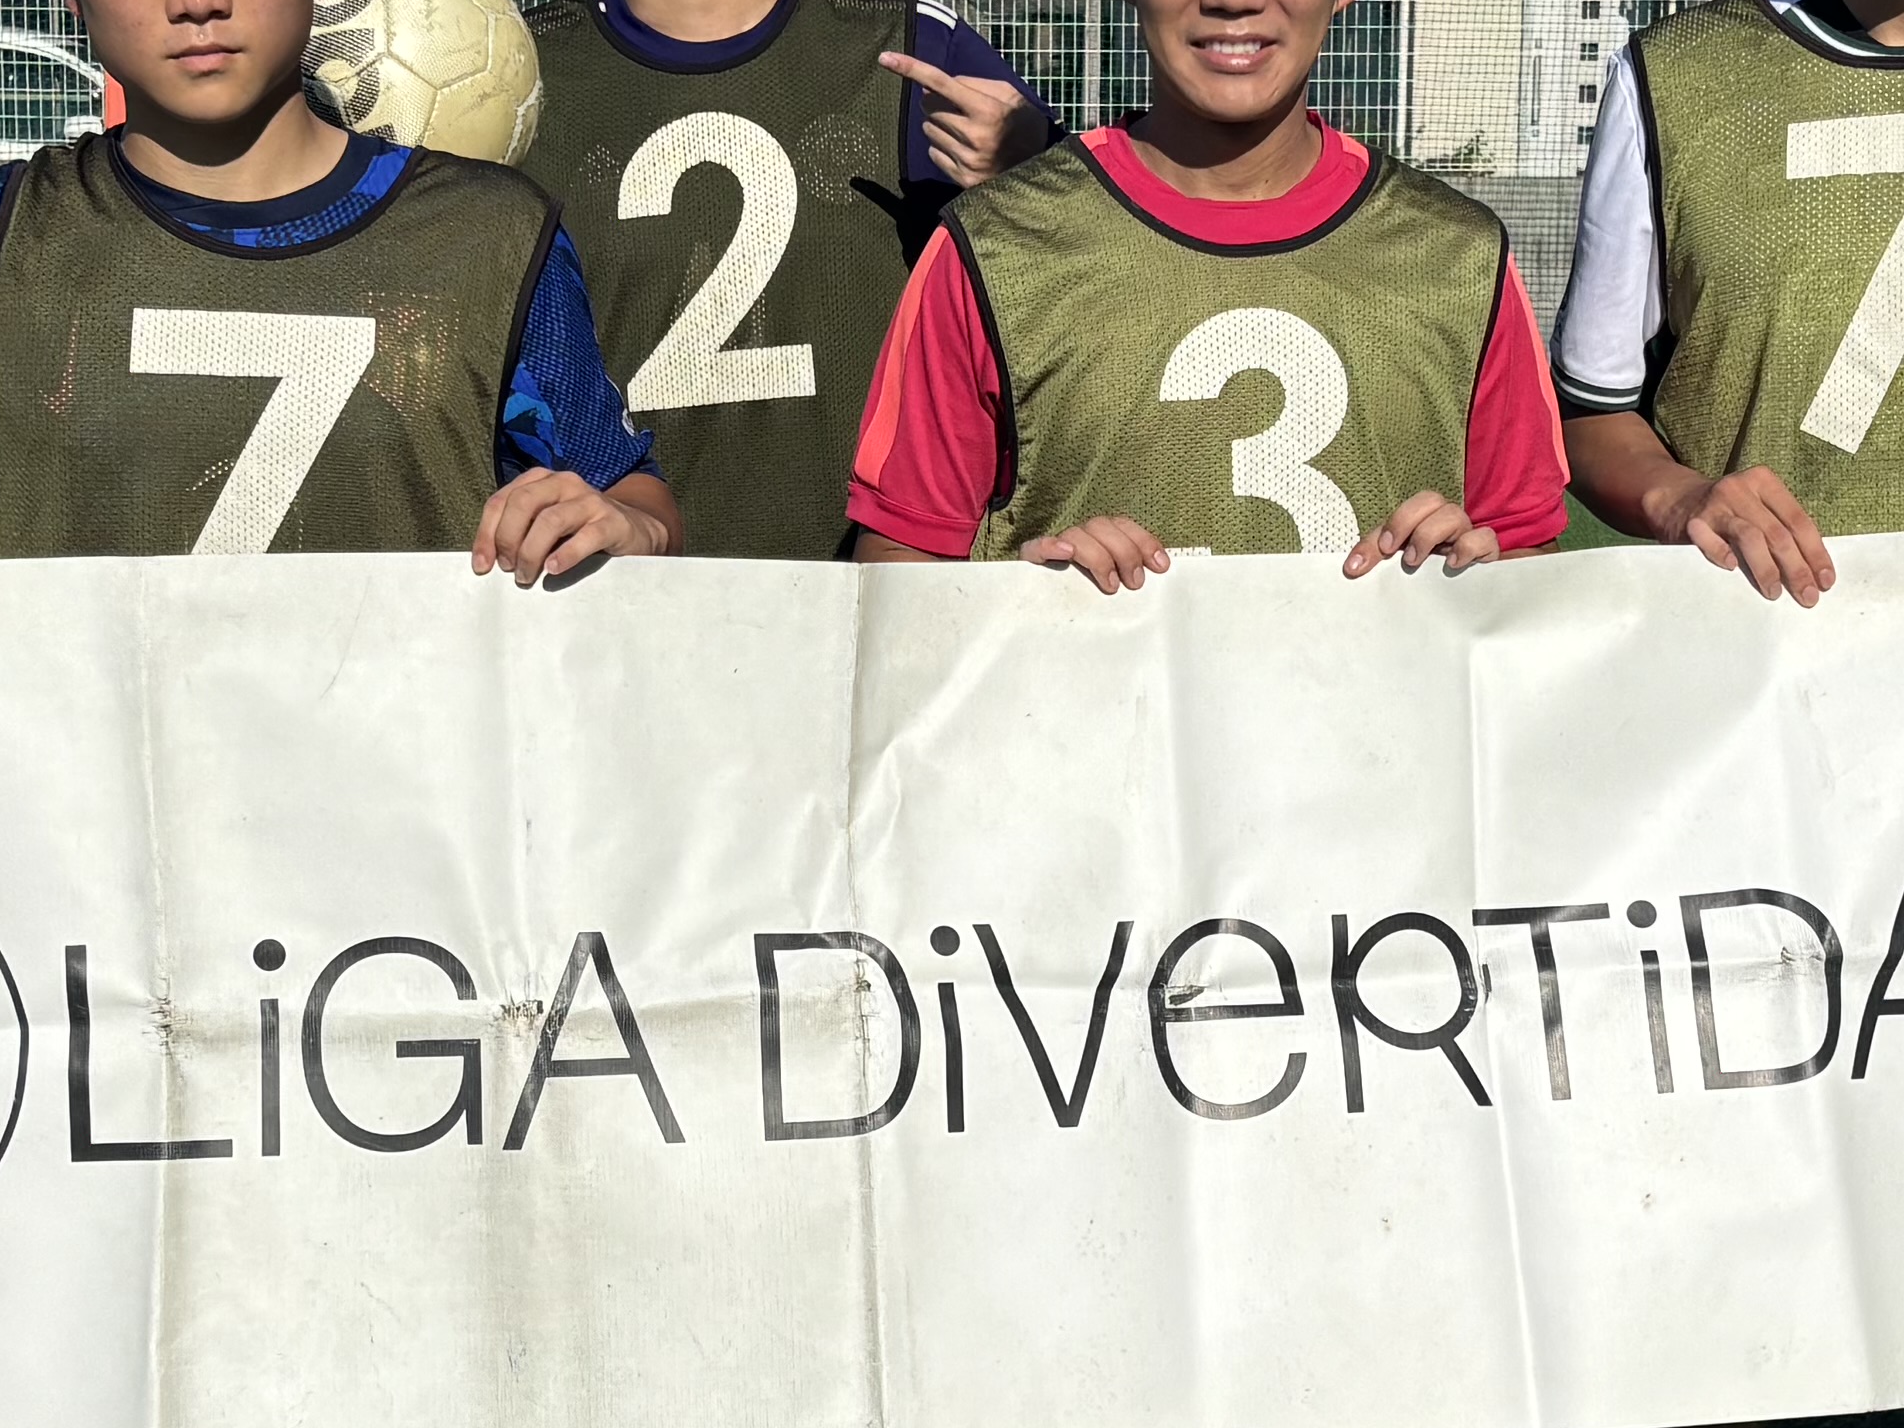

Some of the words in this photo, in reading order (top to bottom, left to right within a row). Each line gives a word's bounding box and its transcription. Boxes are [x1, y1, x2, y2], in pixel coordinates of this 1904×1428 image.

[618, 112, 815, 412] 2
[129, 308, 376, 555] 7
[1159, 307, 1361, 555] 3
